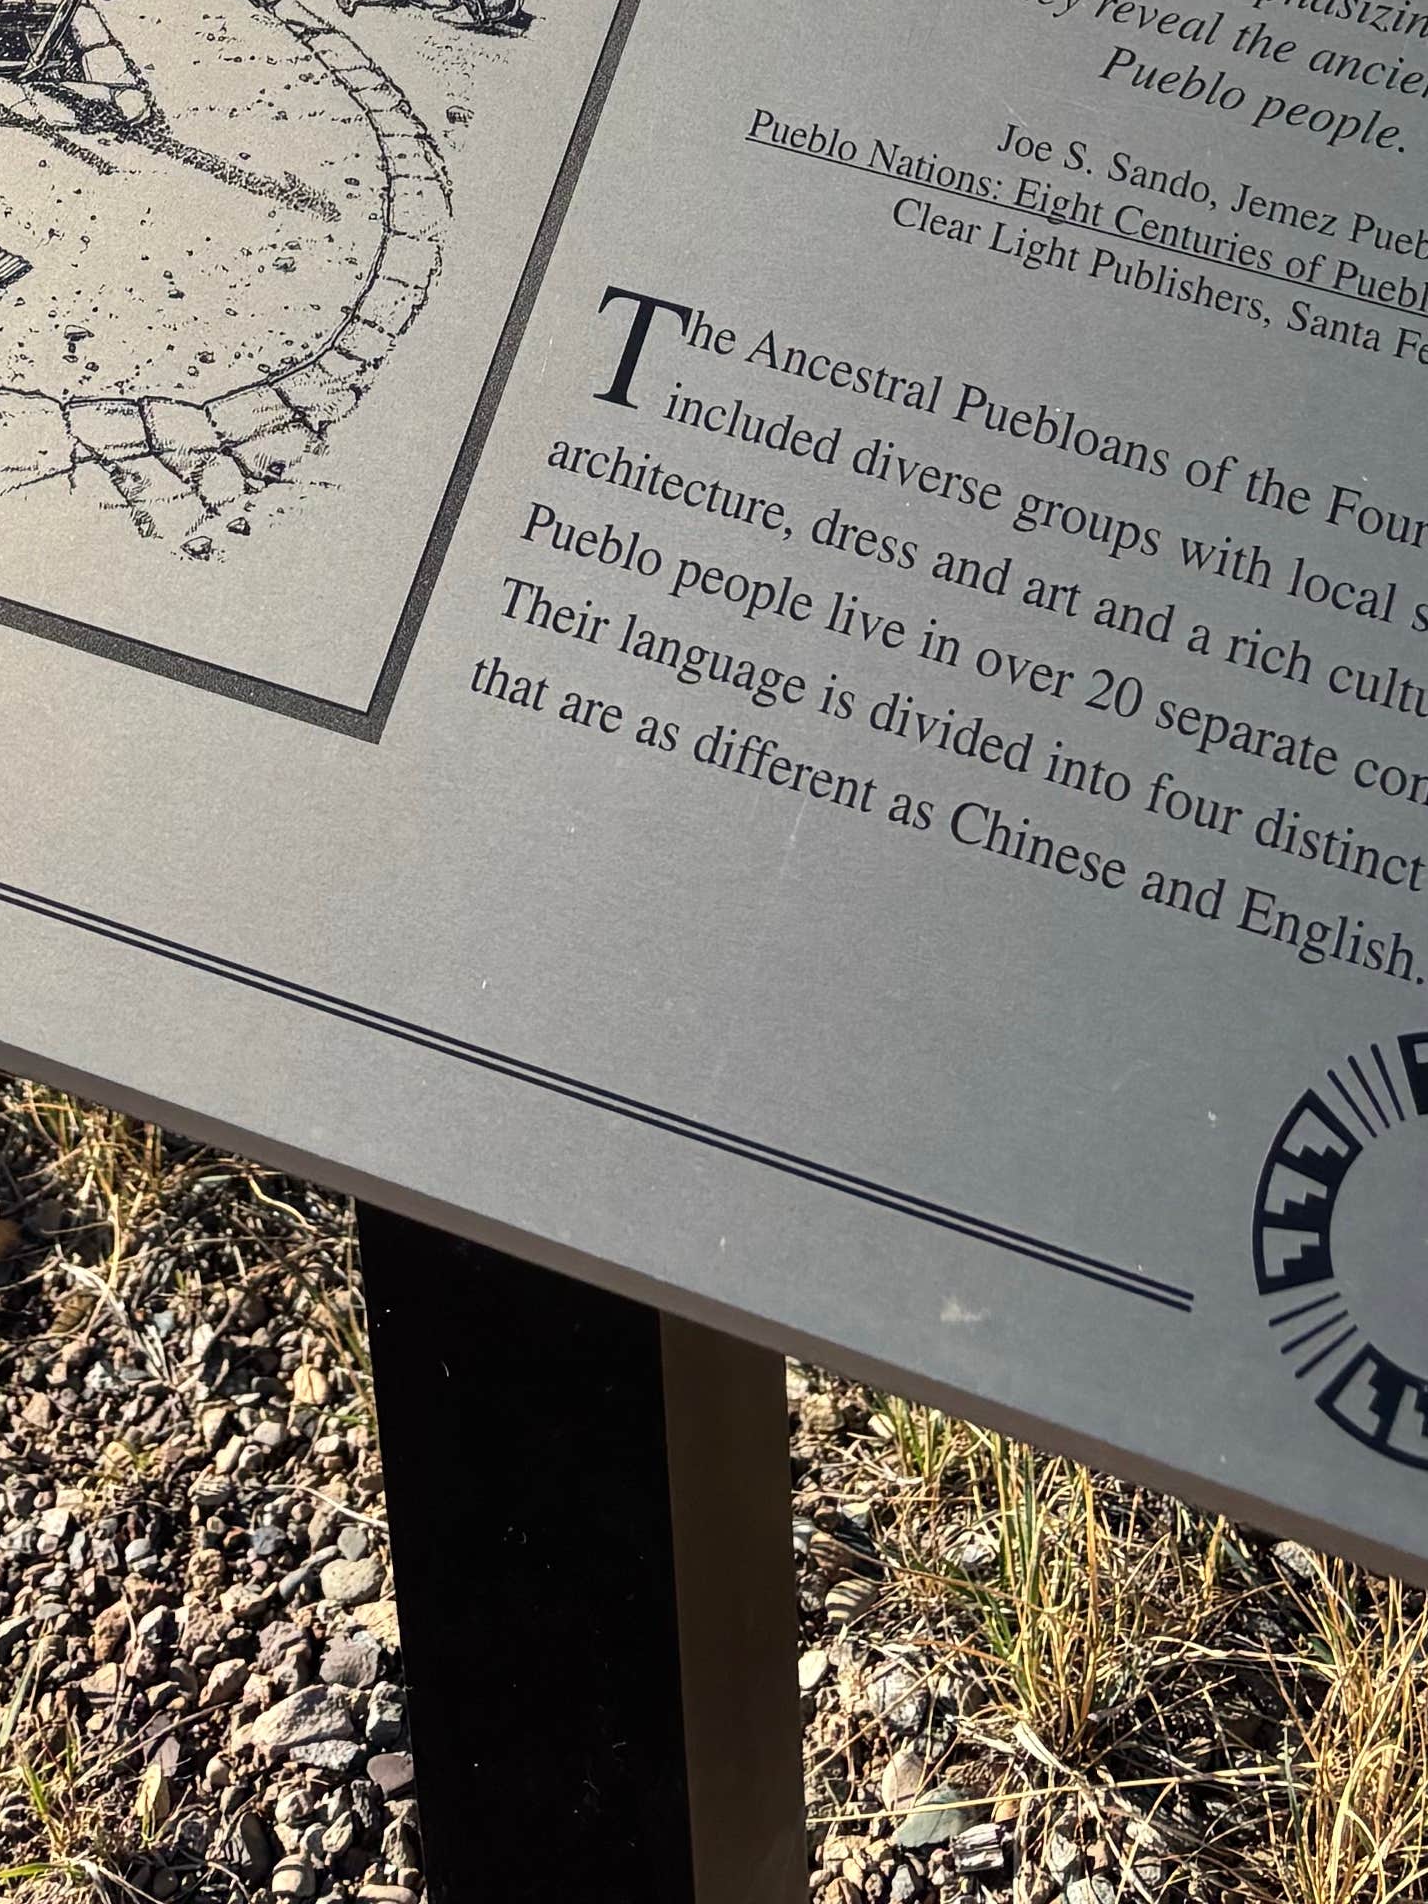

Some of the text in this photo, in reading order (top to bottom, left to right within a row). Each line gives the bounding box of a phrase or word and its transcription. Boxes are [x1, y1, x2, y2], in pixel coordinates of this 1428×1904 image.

[1096, 44, 1406, 154] Pueblo people.
[1230, 20, 1298, 64] the
[746, 106, 859, 162] Pueblo
[865, 137, 1003, 201] Nations:
[1011, 175, 1104, 228] Eight
[1112, 202, 1274, 272] Centuries
[1283, 252, 1328, 284] of
[891, 195, 983, 246] Clear
[986, 219, 1081, 273] Light
[1086, 245, 1272, 329] Publishers,
[1284, 298, 1381, 353] Santa
[994, 121, 1054, 164] Joe
[1061, 138, 1093, 176] S.
[1105, 149, 1218, 212] Sando,
[1228, 181, 1339, 238] Jemez
[591, 283, 738, 411] The
[742, 328, 944, 415] Ancestral
[950, 381, 1171, 478] Puebloans
[1183, 453, 1240, 494] of
[1243, 465, 1312, 516] the
[660, 380, 843, 466] included
[850, 436, 1003, 512] diverse
[1010, 491, 1162, 561] groups
[1179, 534, 1272, 590] with
[1285, 555, 1398, 624] local
[518, 499, 663, 578] Pueblo
[667, 557, 814, 623] people
[822, 589, 907, 650] live
[916, 616, 961, 668] in
[973, 646, 1076, 700] over
[1083, 666, 1144, 719] 20
[1153, 698, 1339, 777] separate
[545, 438, 793, 542] architecture,
[809, 506, 919, 571] dress
[930, 550, 1014, 597] and
[1020, 575, 1082, 618] art
[1091, 596, 1177, 644] and
[1185, 623, 1212, 657] a
[1223, 626, 1313, 686] rich
[469, 654, 1425, 986] that are as different as Chinese and English.
[499, 574, 611, 646] Their
[616, 611, 807, 709] language
[817, 671, 856, 721] is
[867, 690, 1035, 774] divided
[1042, 738, 1132, 803] into
[1143, 770, 1244, 836] four
[1253, 805, 1426, 893] distinct
